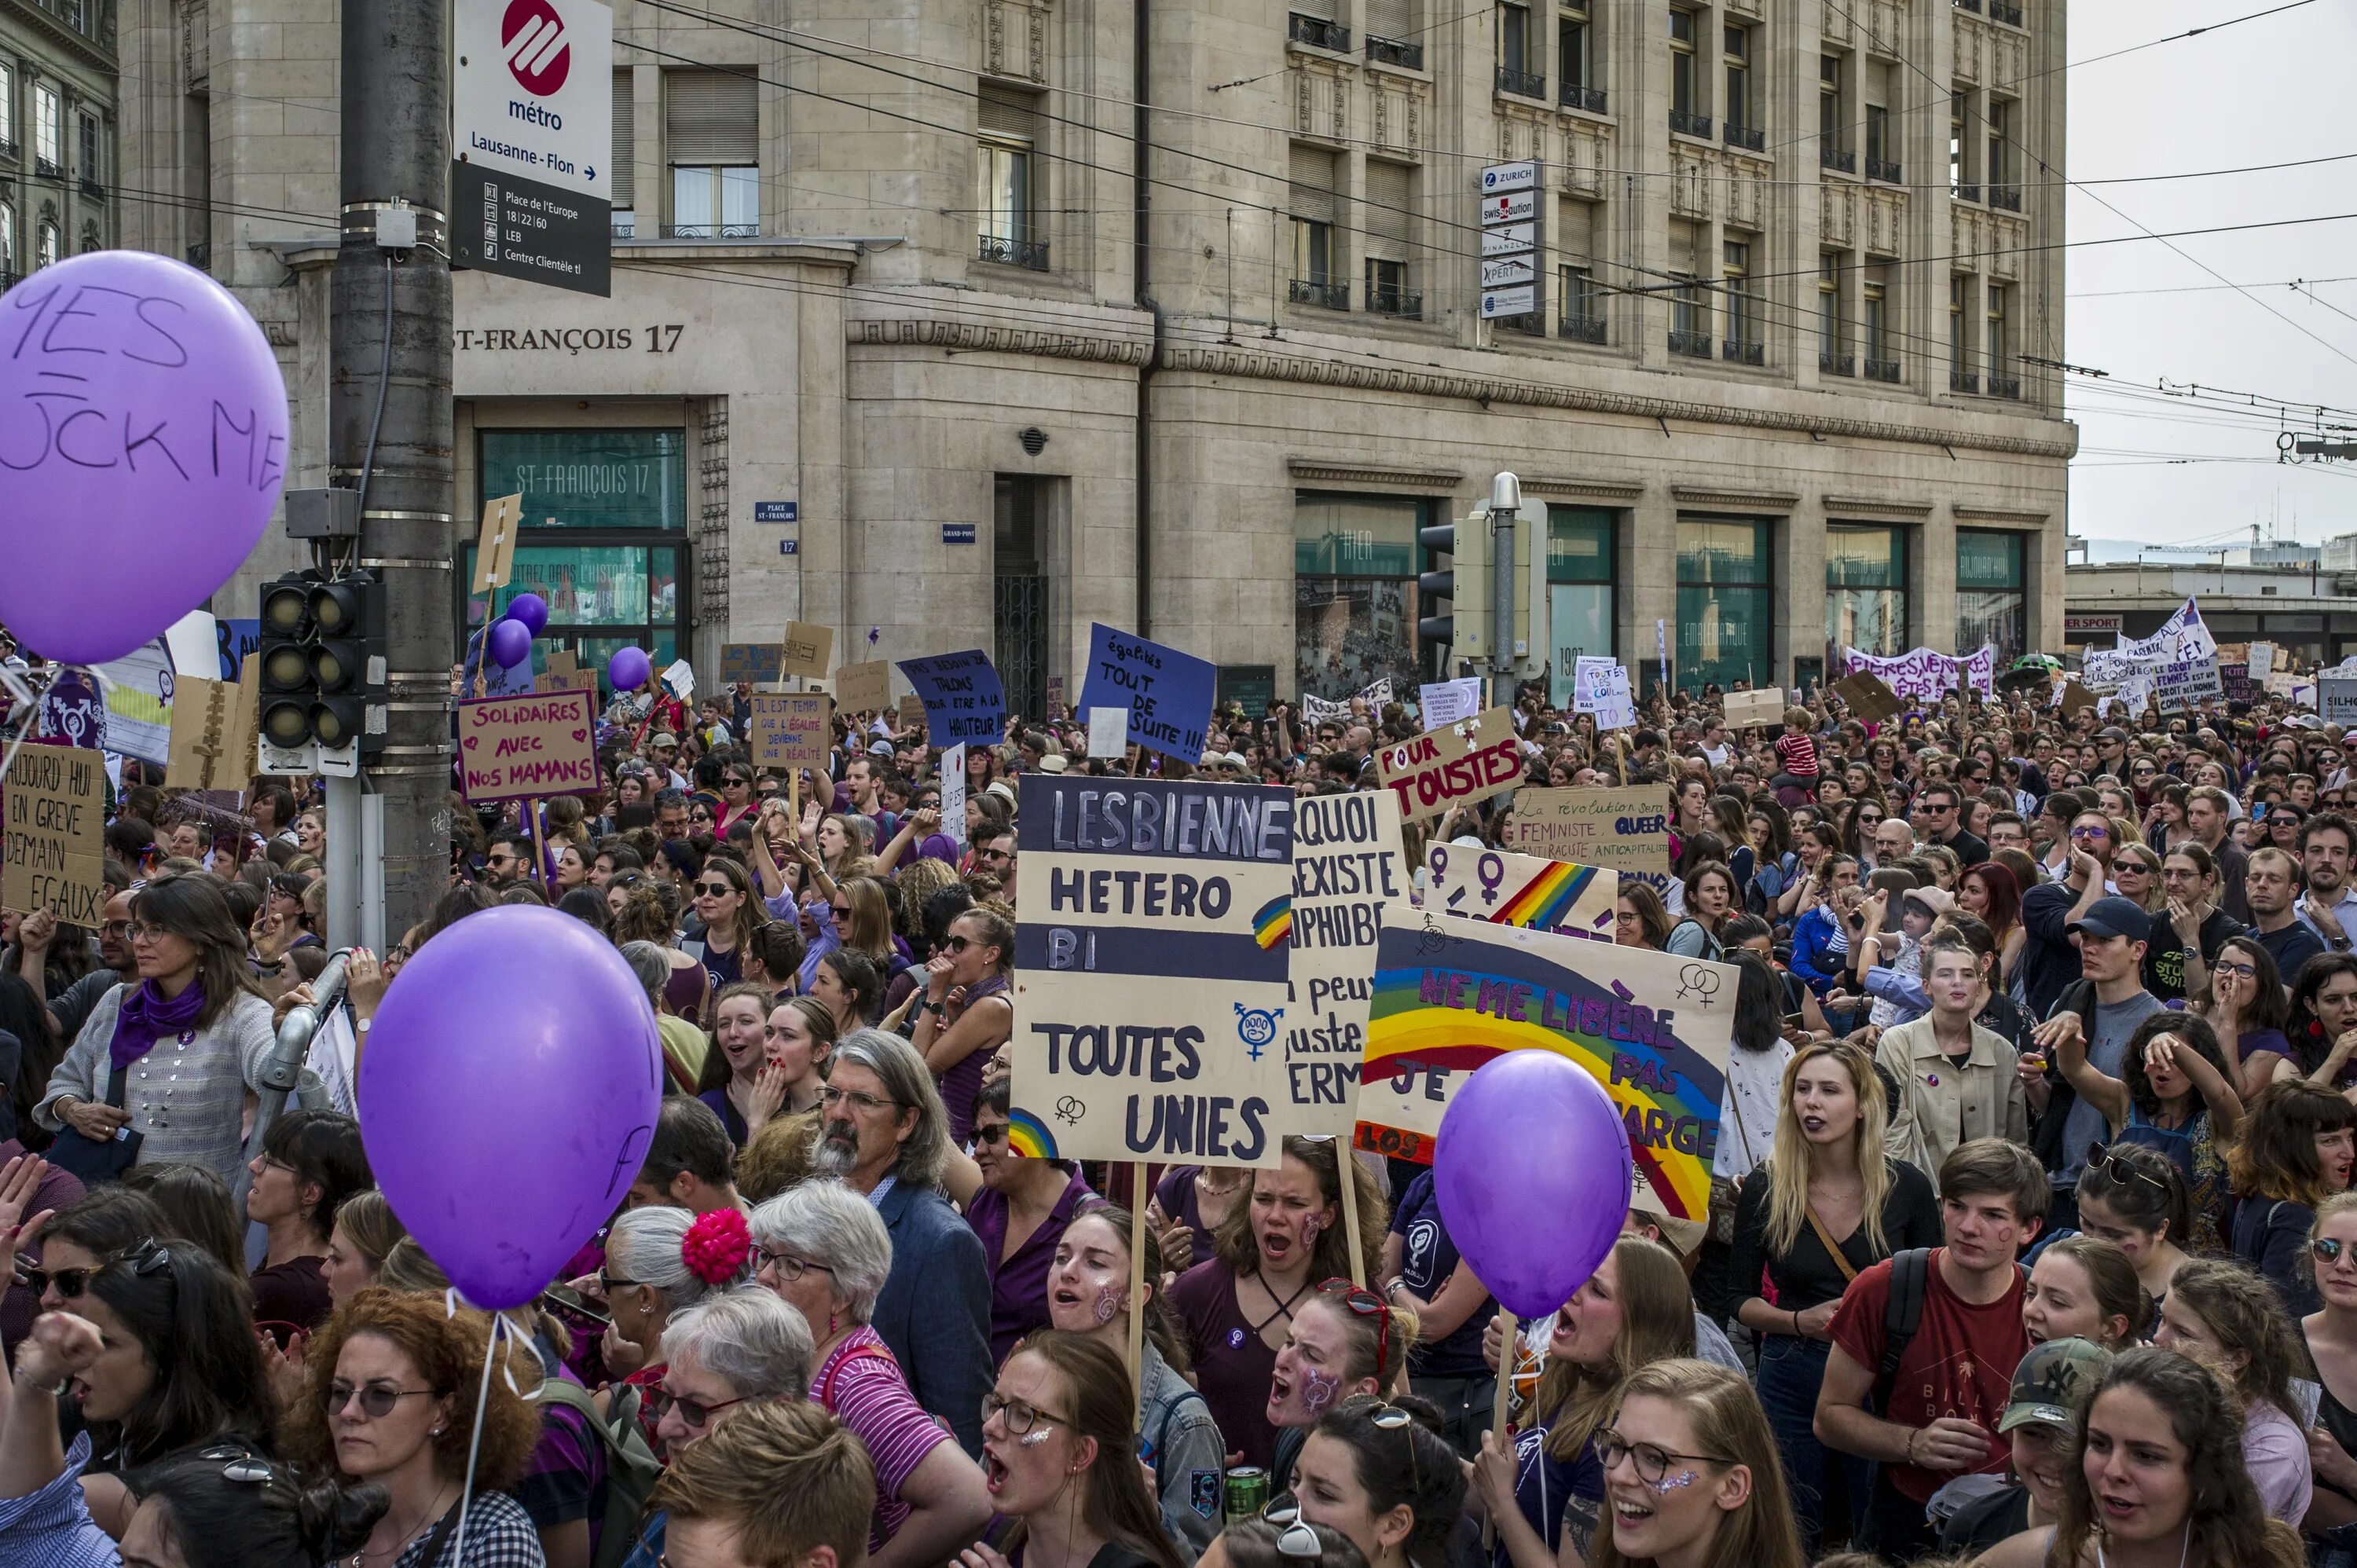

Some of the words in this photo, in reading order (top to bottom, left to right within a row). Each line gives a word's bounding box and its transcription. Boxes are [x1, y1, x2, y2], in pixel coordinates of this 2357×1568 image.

[509, 100, 562, 130] métro
[472, 131, 537, 164] Lausanne
[547, 153, 574, 175] Flon
[1500, 170, 1532, 182] ZURICH
[506, 192, 529, 207] Place
[530, 196, 541, 211] de
[543, 199, 578, 219] l'Europe
[1483, 202, 1532, 219] swisscaution
[506, 229, 522, 243] LEB
[1483, 240, 1533, 252] FINANZLAB
[505, 248, 534, 265] Centre
[536, 255, 573, 273] Clientèle
[574, 264, 581, 275] tl
[15, 284, 188, 368] YES
[645, 324, 684, 353] 17
[517, 464, 626, 498] ST-FRANÇOIS
[634, 464, 649, 494] 17
[783, 542, 794, 552] 17
[1344, 529, 1372, 559] HIER
[548, 564, 576, 583] DANS
[1960, 555, 2005, 578] AUJOURD'HUI
[2082, 618, 2120, 628] SPORT
[1108, 635, 1162, 669] égalités
[908, 662, 930, 675] PAS
[933, 658, 971, 671] BESOIN
[1101, 661, 1154, 692] TOUT
[1588, 667, 1626, 680] TOUTES
[2157, 672, 2189, 686] FEMMES
[2168, 661, 2192, 672] DROIT
[931, 676, 973, 692] TALONS
[1593, 677, 1611, 688] LES
[2159, 686, 2181, 698] DROIT
[771, 700, 788, 713] EST
[792, 700, 818, 713] TEMPS
[953, 697, 975, 709] ETRE
[990, 694, 1000, 706] LA
[1132, 694, 1157, 717] DE
[761, 718, 775, 729] QUE
[949, 716, 995, 737] HAUTEUR
[1129, 713, 1182, 745] SUITE
[495, 736, 543, 757] AVEC
[768, 732, 803, 745] DEVIENNE
[763, 749, 779, 758] UNE
[510, 758, 592, 786] MAMANS
[1387, 738, 1522, 817] TOUSTES
[942, 791, 953, 811] CUP
[955, 786, 964, 807] EST
[1516, 791, 1544, 818] La
[1558, 800, 1635, 815] révolution
[13, 794, 27, 824] EN
[36, 797, 83, 836] GREVE
[1054, 790, 1290, 860] LESBIENNE
[7, 831, 64, 872] DEMAIN
[1595, 844, 1669, 857] ANTICAPITALISTE
[31, 874, 99, 922] EGAUX
[1051, 866, 1232, 919] HETERO
[1047, 928, 1096, 970] BI
[1420, 968, 1472, 1009] NE
[1475, 978, 1532, 1022] ME
[1541, 979, 1675, 1050] LIBÈRE
[1031, 1022, 1205, 1082] TOUTES
[1391, 1057, 1451, 1101] JE
[1610, 1051, 1680, 1094] PAS
[1125, 1094, 1270, 1160] UNIES
[1361, 1125, 1420, 1159] LOS
